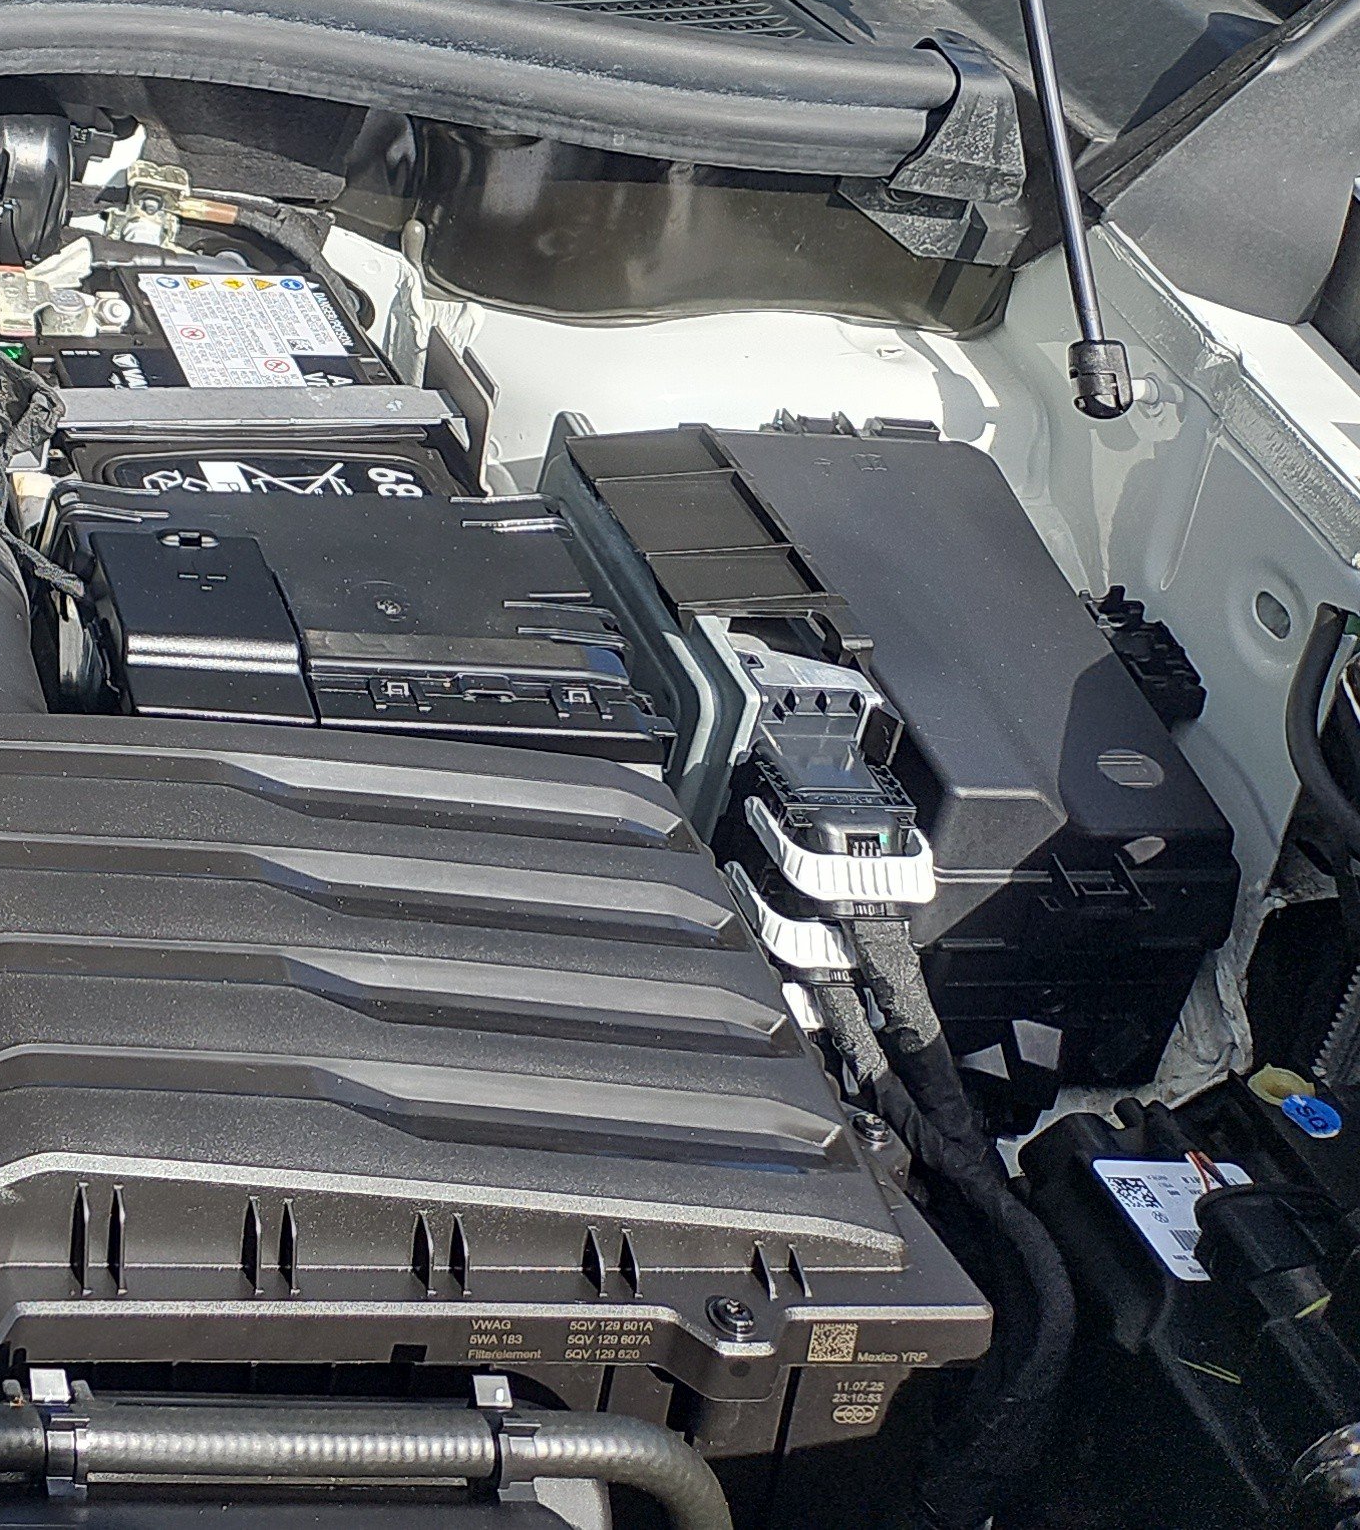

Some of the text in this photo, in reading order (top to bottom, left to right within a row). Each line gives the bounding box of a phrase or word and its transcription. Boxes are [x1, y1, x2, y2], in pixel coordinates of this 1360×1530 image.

[471, 1319, 512, 1330] VWAG
[599, 1321, 621, 1331] 129
[598, 1334, 618, 1345] 129
[594, 1349, 615, 1359] 129
[857, 1352, 898, 1362] Mexico
